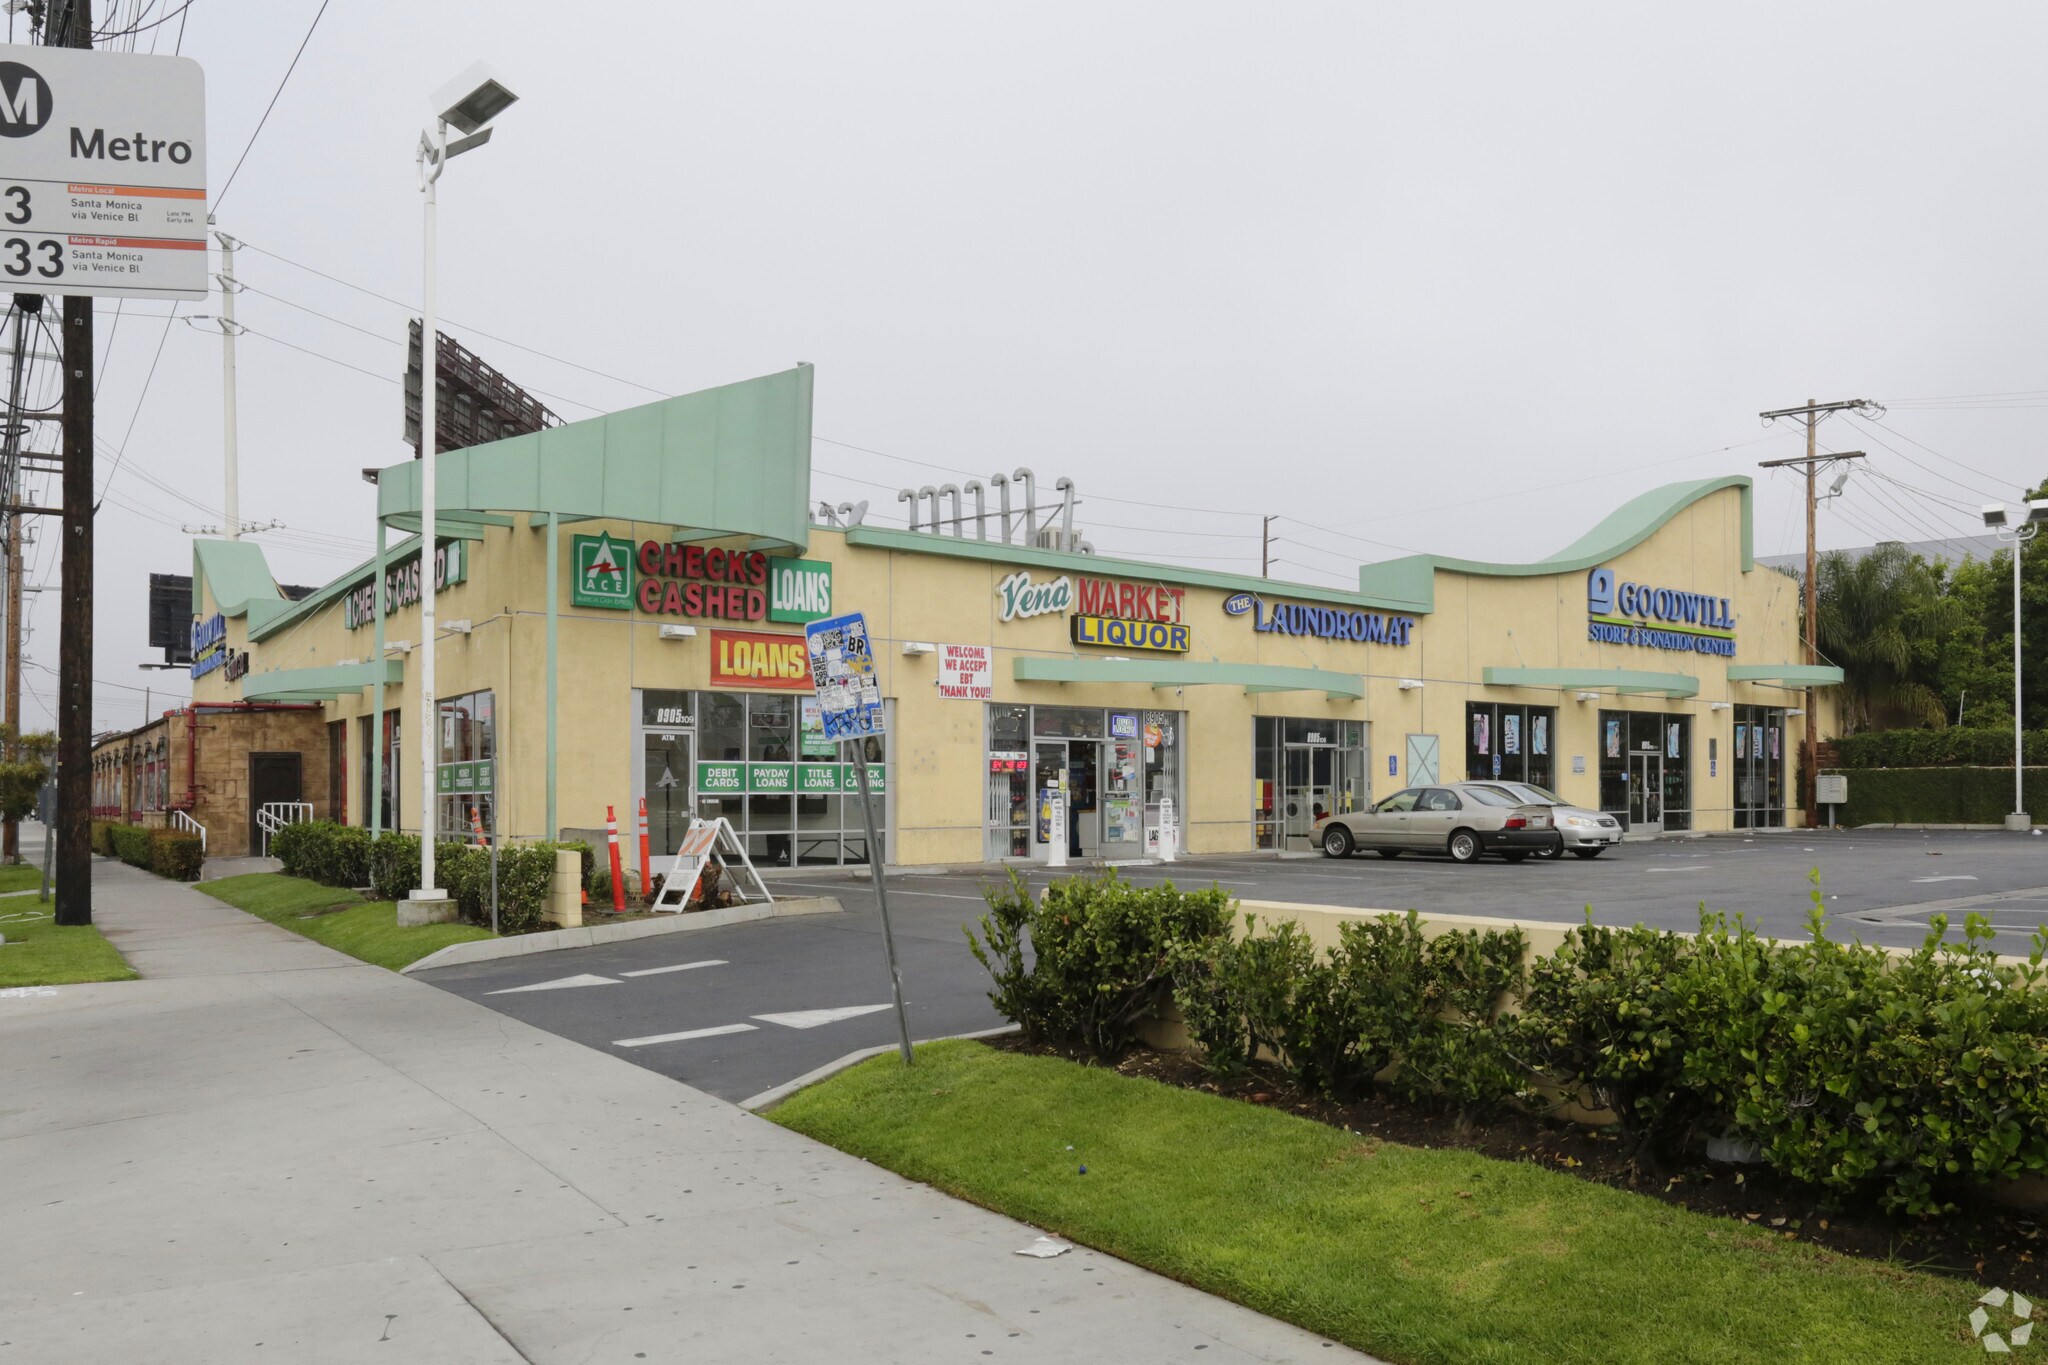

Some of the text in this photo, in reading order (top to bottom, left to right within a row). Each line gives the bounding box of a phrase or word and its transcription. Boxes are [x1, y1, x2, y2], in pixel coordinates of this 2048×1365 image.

[70, 126, 192, 164] Metro
[70, 185, 115, 195] Metro Local
[4, 186, 32, 225] 3
[71, 198, 142, 211] Santa Monica
[72, 211, 139, 222] via Venice Bl
[166, 217, 182, 225] Early
[70, 236, 117, 247] Metro Rapid
[4, 237, 64, 278] 33
[72, 250, 143, 262] Santa Monica
[72, 262, 140, 274] via Venice Bl
[637, 540, 767, 586] CHECKS
[352, 574, 393, 628] CHECS
[396, 548, 446, 608] CASD
[586, 579, 622, 592] ACE
[772, 568, 829, 614] LOANS
[637, 578, 766, 621] CASHED
[1001, 575, 1071, 620] Vena
[1078, 577, 1185, 623] MARKET
[1229, 597, 1250, 611] THE
[1618, 582, 1736, 629] GOODWILL
[1253, 600, 1415, 645] LAUNDROMAT
[1078, 617, 1188, 650] LIQUOR
[1588, 623, 1737, 657] STORE & DONATION CENTER
[847, 635, 865, 656] BR
[946, 645, 985, 659] WELCOME
[719, 639, 805, 679] LOANS
[945, 659, 988, 673] WE ACCEPT
[959, 672, 974, 685] EBT
[939, 684, 991, 699] THANK YOU!!
[657, 708, 682, 723] 8905
[1116, 717, 1133, 726] BUD
[1113, 724, 1135, 735] LIGHT
[458, 768, 470, 778] MONEY
[480, 767, 490, 777] DEBIT
[707, 768, 737, 778] DEBIT
[753, 768, 790, 778] PAYDAY
[807, 769, 833, 778] TITLE
[850, 769, 880, 779] CCK
[479, 777, 491, 787] CARDS
[705, 777, 740, 788] CARDS
[755, 778, 788, 788] LOANS
[804, 778, 835, 788] LOANS
[845, 778, 885, 788] CAING
